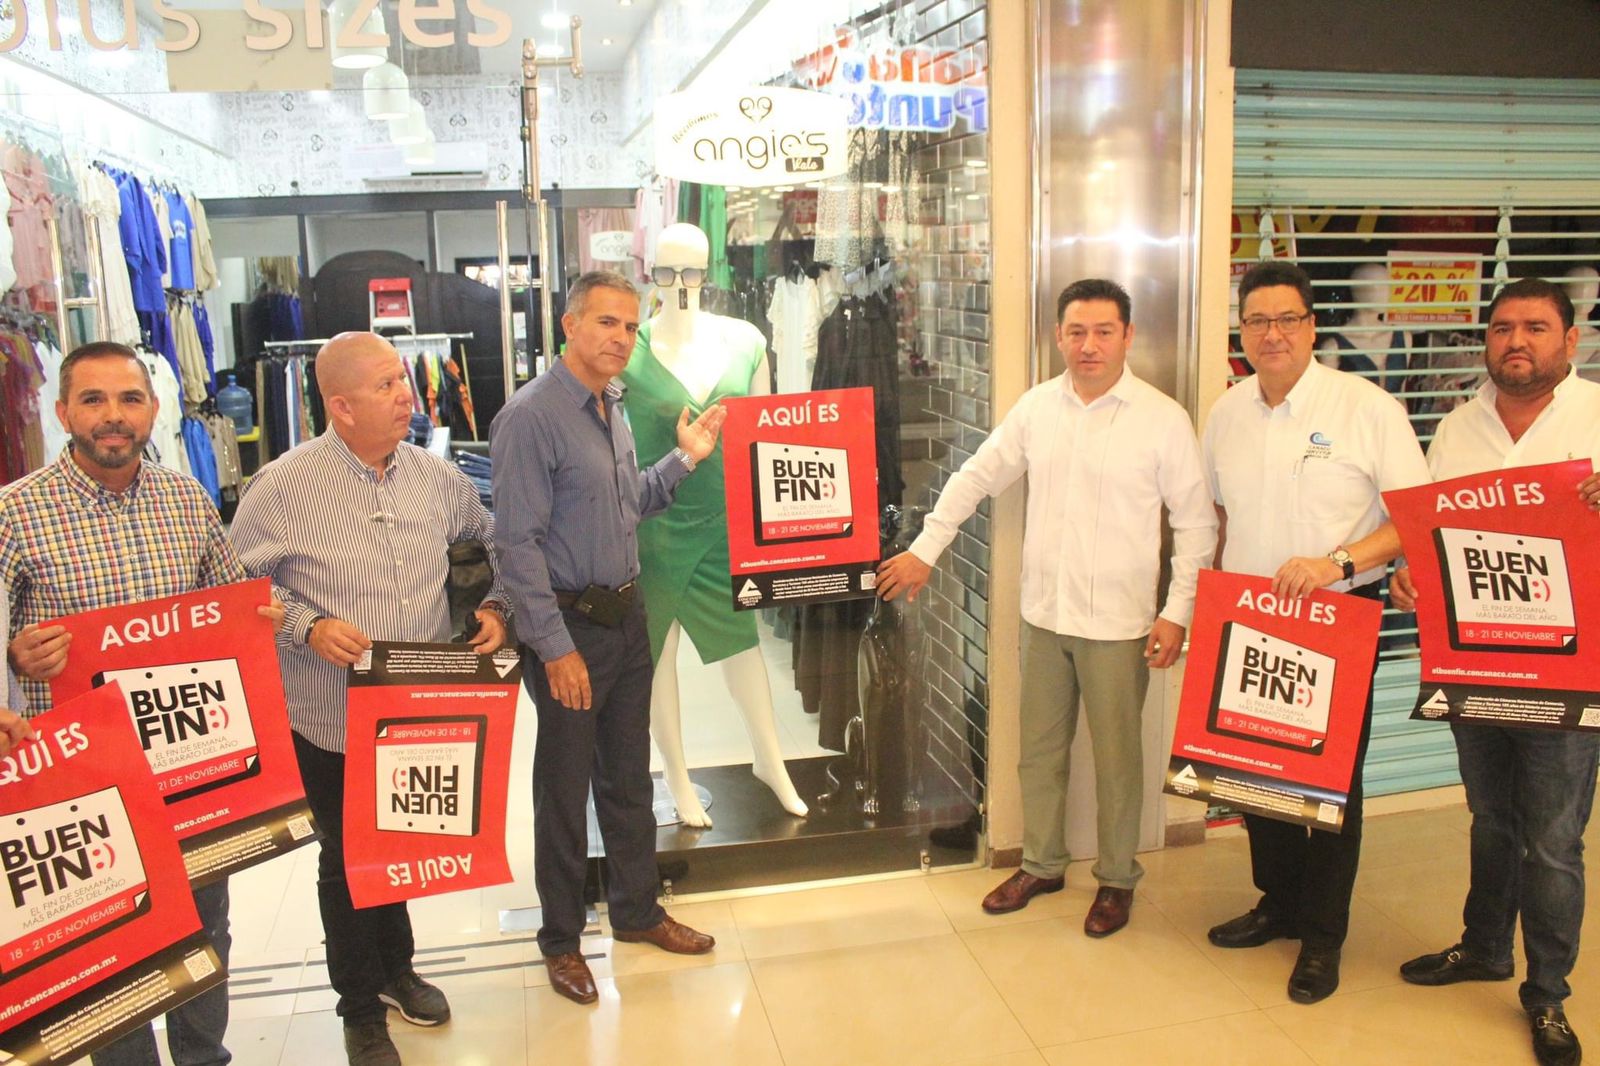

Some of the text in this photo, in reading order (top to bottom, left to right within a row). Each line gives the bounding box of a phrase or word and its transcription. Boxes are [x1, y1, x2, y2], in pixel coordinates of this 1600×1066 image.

[244, 0, 512, 51] sizes
[694, 129, 829, 170] angie's
[757, 400, 840, 428] AQUÍ ES
[772, 459, 835, 479] BUEN
[1436, 479, 1545, 513] AQUÍ ES
[768, 527, 776, 535] 18
[790, 525, 799, 533] DE
[800, 522, 839, 532] NOVIEMBRE
[1463, 547, 1549, 576] BUEN
[1236, 589, 1337, 626] AQUÍ ES
[100, 601, 222, 651] AQUÍ ES
[1465, 629, 1474, 638] 18
[1481, 630, 1490, 639] 21
[1491, 630, 1504, 639] DE
[1505, 631, 1557, 641] NOVIEMBRE
[1243, 645, 1317, 687] BUEN
[130, 680, 226, 718] BUEN
[54, 721, 89, 760] ES
[392, 728, 436, 739] NOVIEMBRE
[437, 728, 448, 737] DE
[449, 728, 457, 736] 21
[463, 728, 472, 736] 18
[1223, 717, 1233, 726] 18
[1239, 719, 1247, 729] 21
[1248, 721, 1260, 732] DE
[1260, 724, 1307, 742] NOVIEMBRE
[151, 738, 239, 771] MÁS BARATO DEL AÑO
[155, 735, 228, 761] EL FIN DE SEMANA
[157, 758, 240, 791] 21 DE NOVIEMBRE
[391, 793, 458, 817] BUEN
[0, 813, 111, 872] BUEN
[387, 853, 473, 889] AQUÍ ES
[22, 876, 126, 930] MÁS BARATO DEL AÑO
[30, 876, 114, 917] EL FIN DE SEMANA
[9, 949, 24, 962] 18
[32, 938, 45, 952] 21
[47, 929, 63, 944] DE
[64, 899, 129, 935] NOVIEMBRE
